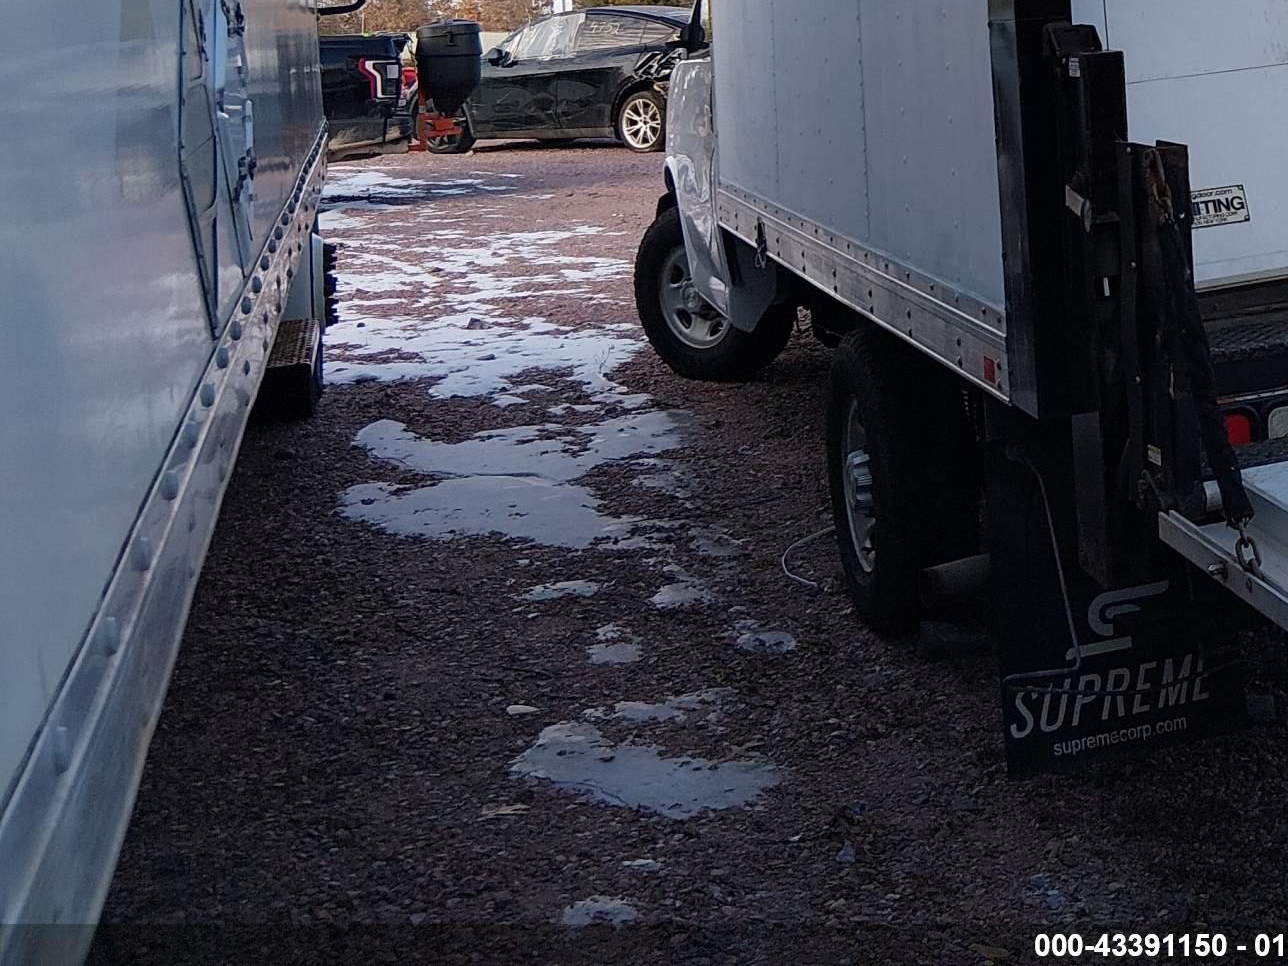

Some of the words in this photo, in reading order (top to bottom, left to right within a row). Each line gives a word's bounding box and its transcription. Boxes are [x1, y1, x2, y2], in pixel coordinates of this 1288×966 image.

[1191, 188, 1233, 200] gdoor.com
[1192, 195, 1245, 216] ITING
[1053, 715, 1187, 757] supremecorp.com
